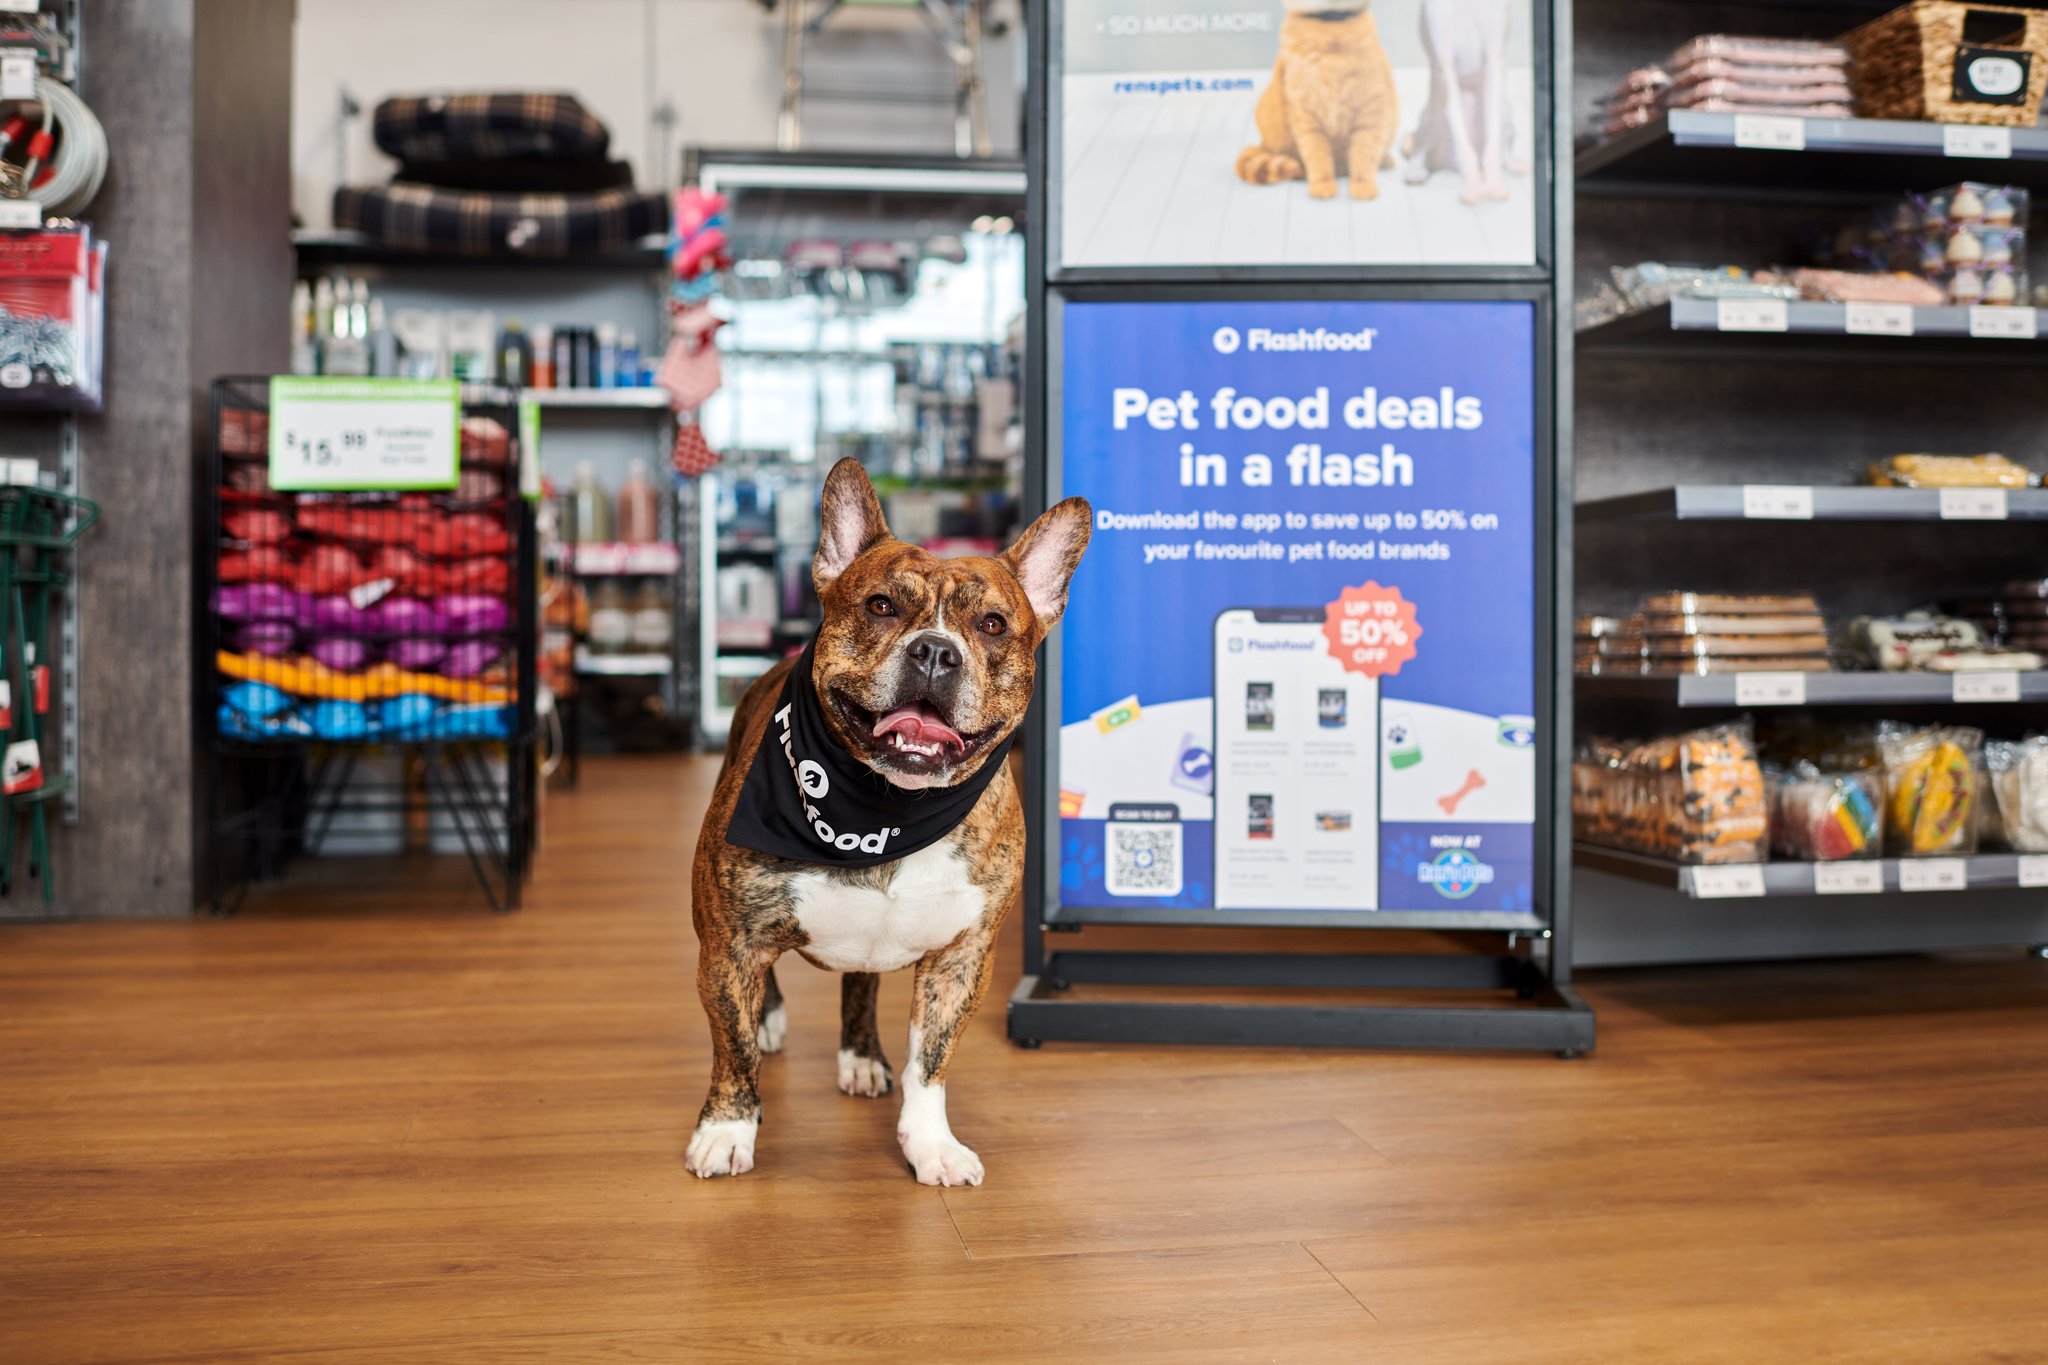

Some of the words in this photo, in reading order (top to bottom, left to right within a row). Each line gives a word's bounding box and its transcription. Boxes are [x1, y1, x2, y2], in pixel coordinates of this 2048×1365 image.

[1109, 15, 1141, 35] SO
[1144, 13, 1207, 34] MUCH
[1210, 11, 1272, 32] MORE
[1113, 76, 1254, 97] renspets.com
[1113, 387, 1200, 430] Pet
[1210, 386, 1330, 430] food
[1343, 386, 1484, 430] deals
[1179, 442, 1228, 487] in
[1241, 453, 1273, 487] a
[1286, 443, 1415, 487] flash
[1097, 510, 1199, 530] Download
[1203, 510, 1238, 530] the
[1241, 513, 1282, 533] app
[1285, 511, 1308, 530] to
[1311, 513, 1360, 530] save
[1363, 513, 1392, 533] up
[1395, 511, 1417, 530] to
[1421, 509, 1468, 530] 50%
[1470, 513, 1499, 530] on
[1144, 543, 1191, 564] your
[1194, 540, 1286, 560] favourite
[1289, 541, 1323, 563] pet
[1327, 539, 1375, 560] food
[1379, 540, 1450, 561] brands
[1344, 601, 1371, 617] UP
[1374, 601, 1398, 617] TO
[1340, 618, 1409, 646] 50%
[1353, 648, 1387, 664] OFF
[1430, 834, 1464, 848] NOW
[1464, 834, 1482, 848] AT
